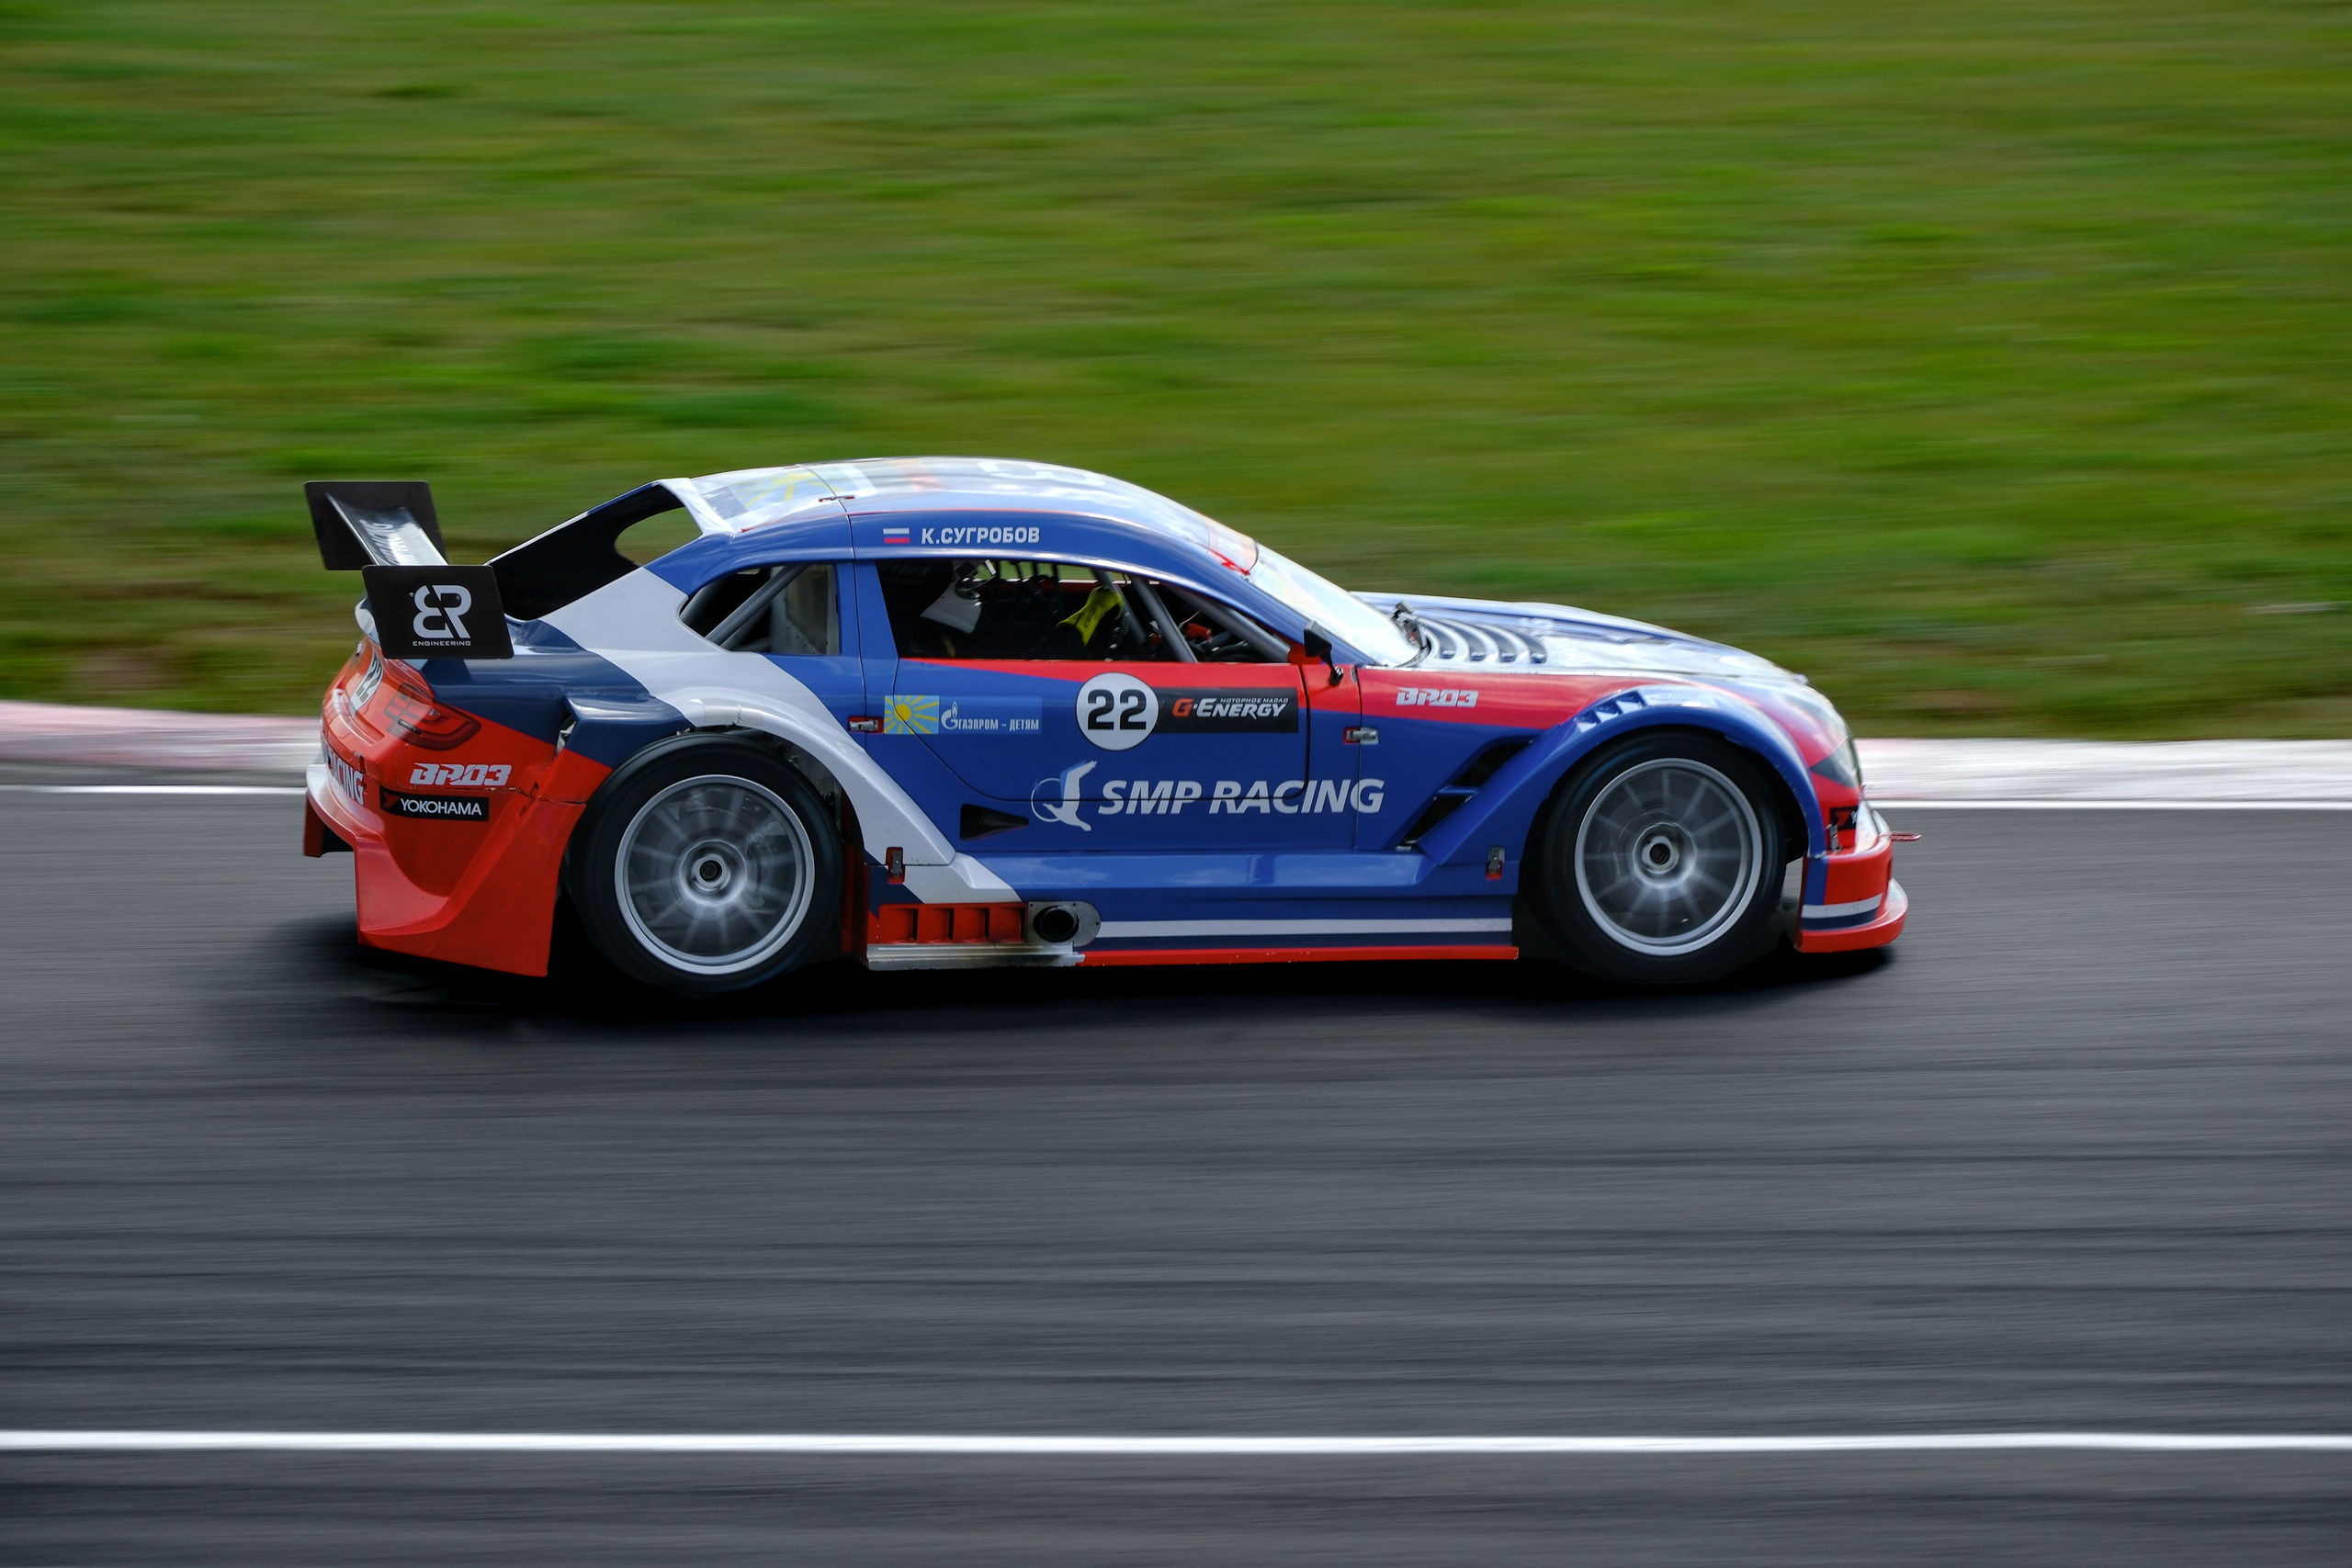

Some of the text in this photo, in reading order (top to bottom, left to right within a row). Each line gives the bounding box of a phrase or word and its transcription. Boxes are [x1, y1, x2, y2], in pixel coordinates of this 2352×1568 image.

[922, 527, 1040, 545] К.СУГРОБОВ
[1088, 689, 1147, 730] 22
[1009, 718, 1039, 731] ДЕТЯМ
[401, 797, 481, 816] YOKOHAMA
[1098, 779, 1385, 815] SMP RACING
